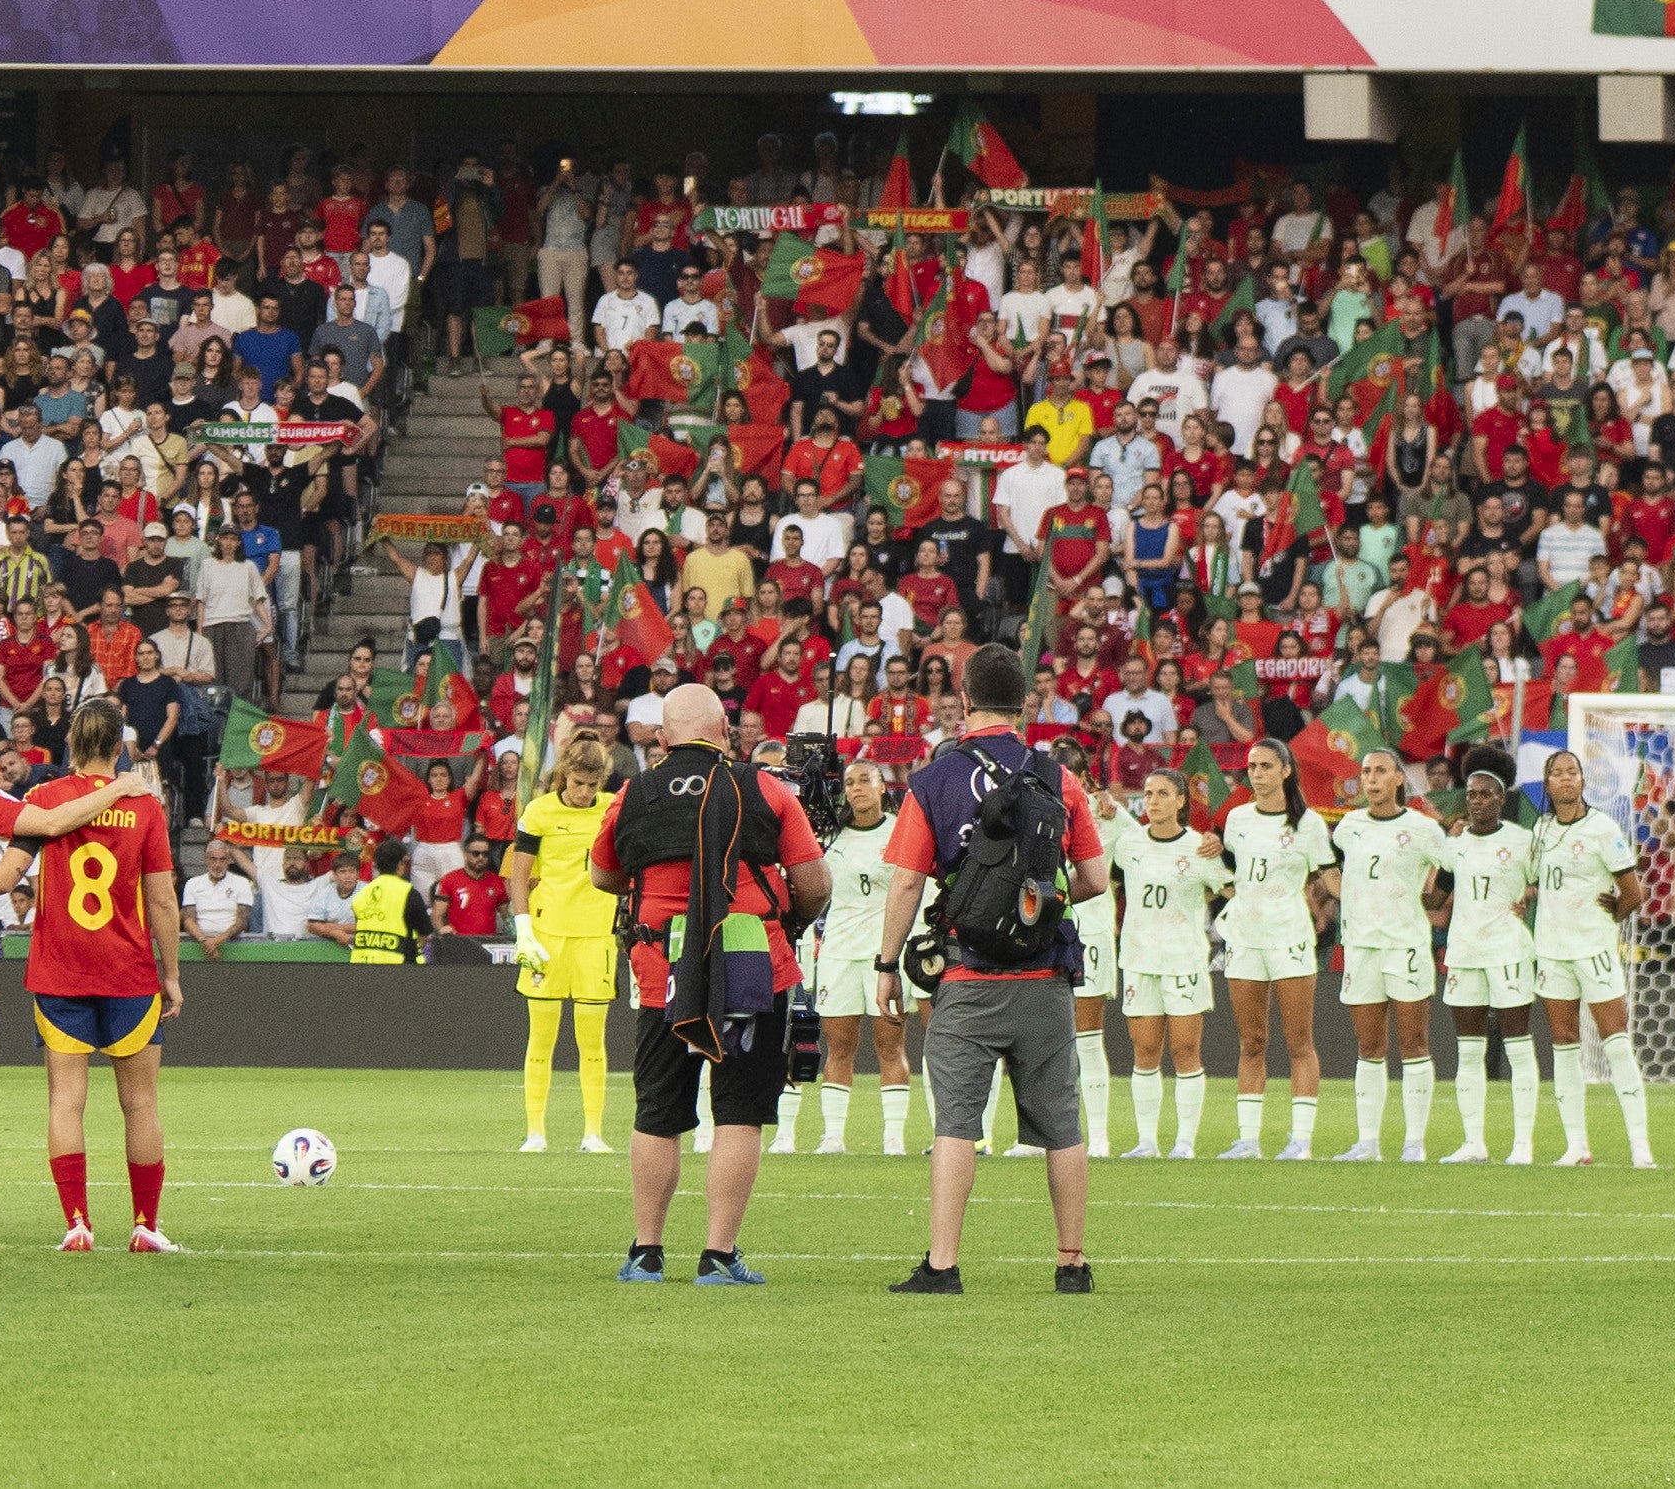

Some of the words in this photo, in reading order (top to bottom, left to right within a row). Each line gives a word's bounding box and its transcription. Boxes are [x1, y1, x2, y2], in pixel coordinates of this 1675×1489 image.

[714, 207, 805, 230] PORTUGAL
[205, 423, 269, 439] CAMPEÕES
[278, 424, 344, 439] EUROPEUS
[375, 517, 488, 540] PORTUGAL
[227, 821, 341, 845] PORTUGAL
[1249, 857, 1267, 882] 13
[1369, 854, 1380, 880] 2
[1545, 864, 1563, 890] 10
[67, 841, 118, 932] 8
[859, 873, 871, 897] 8
[1142, 884, 1168, 909] 20
[1472, 876, 1490, 900] 17
[1406, 948, 1418, 973] 2
